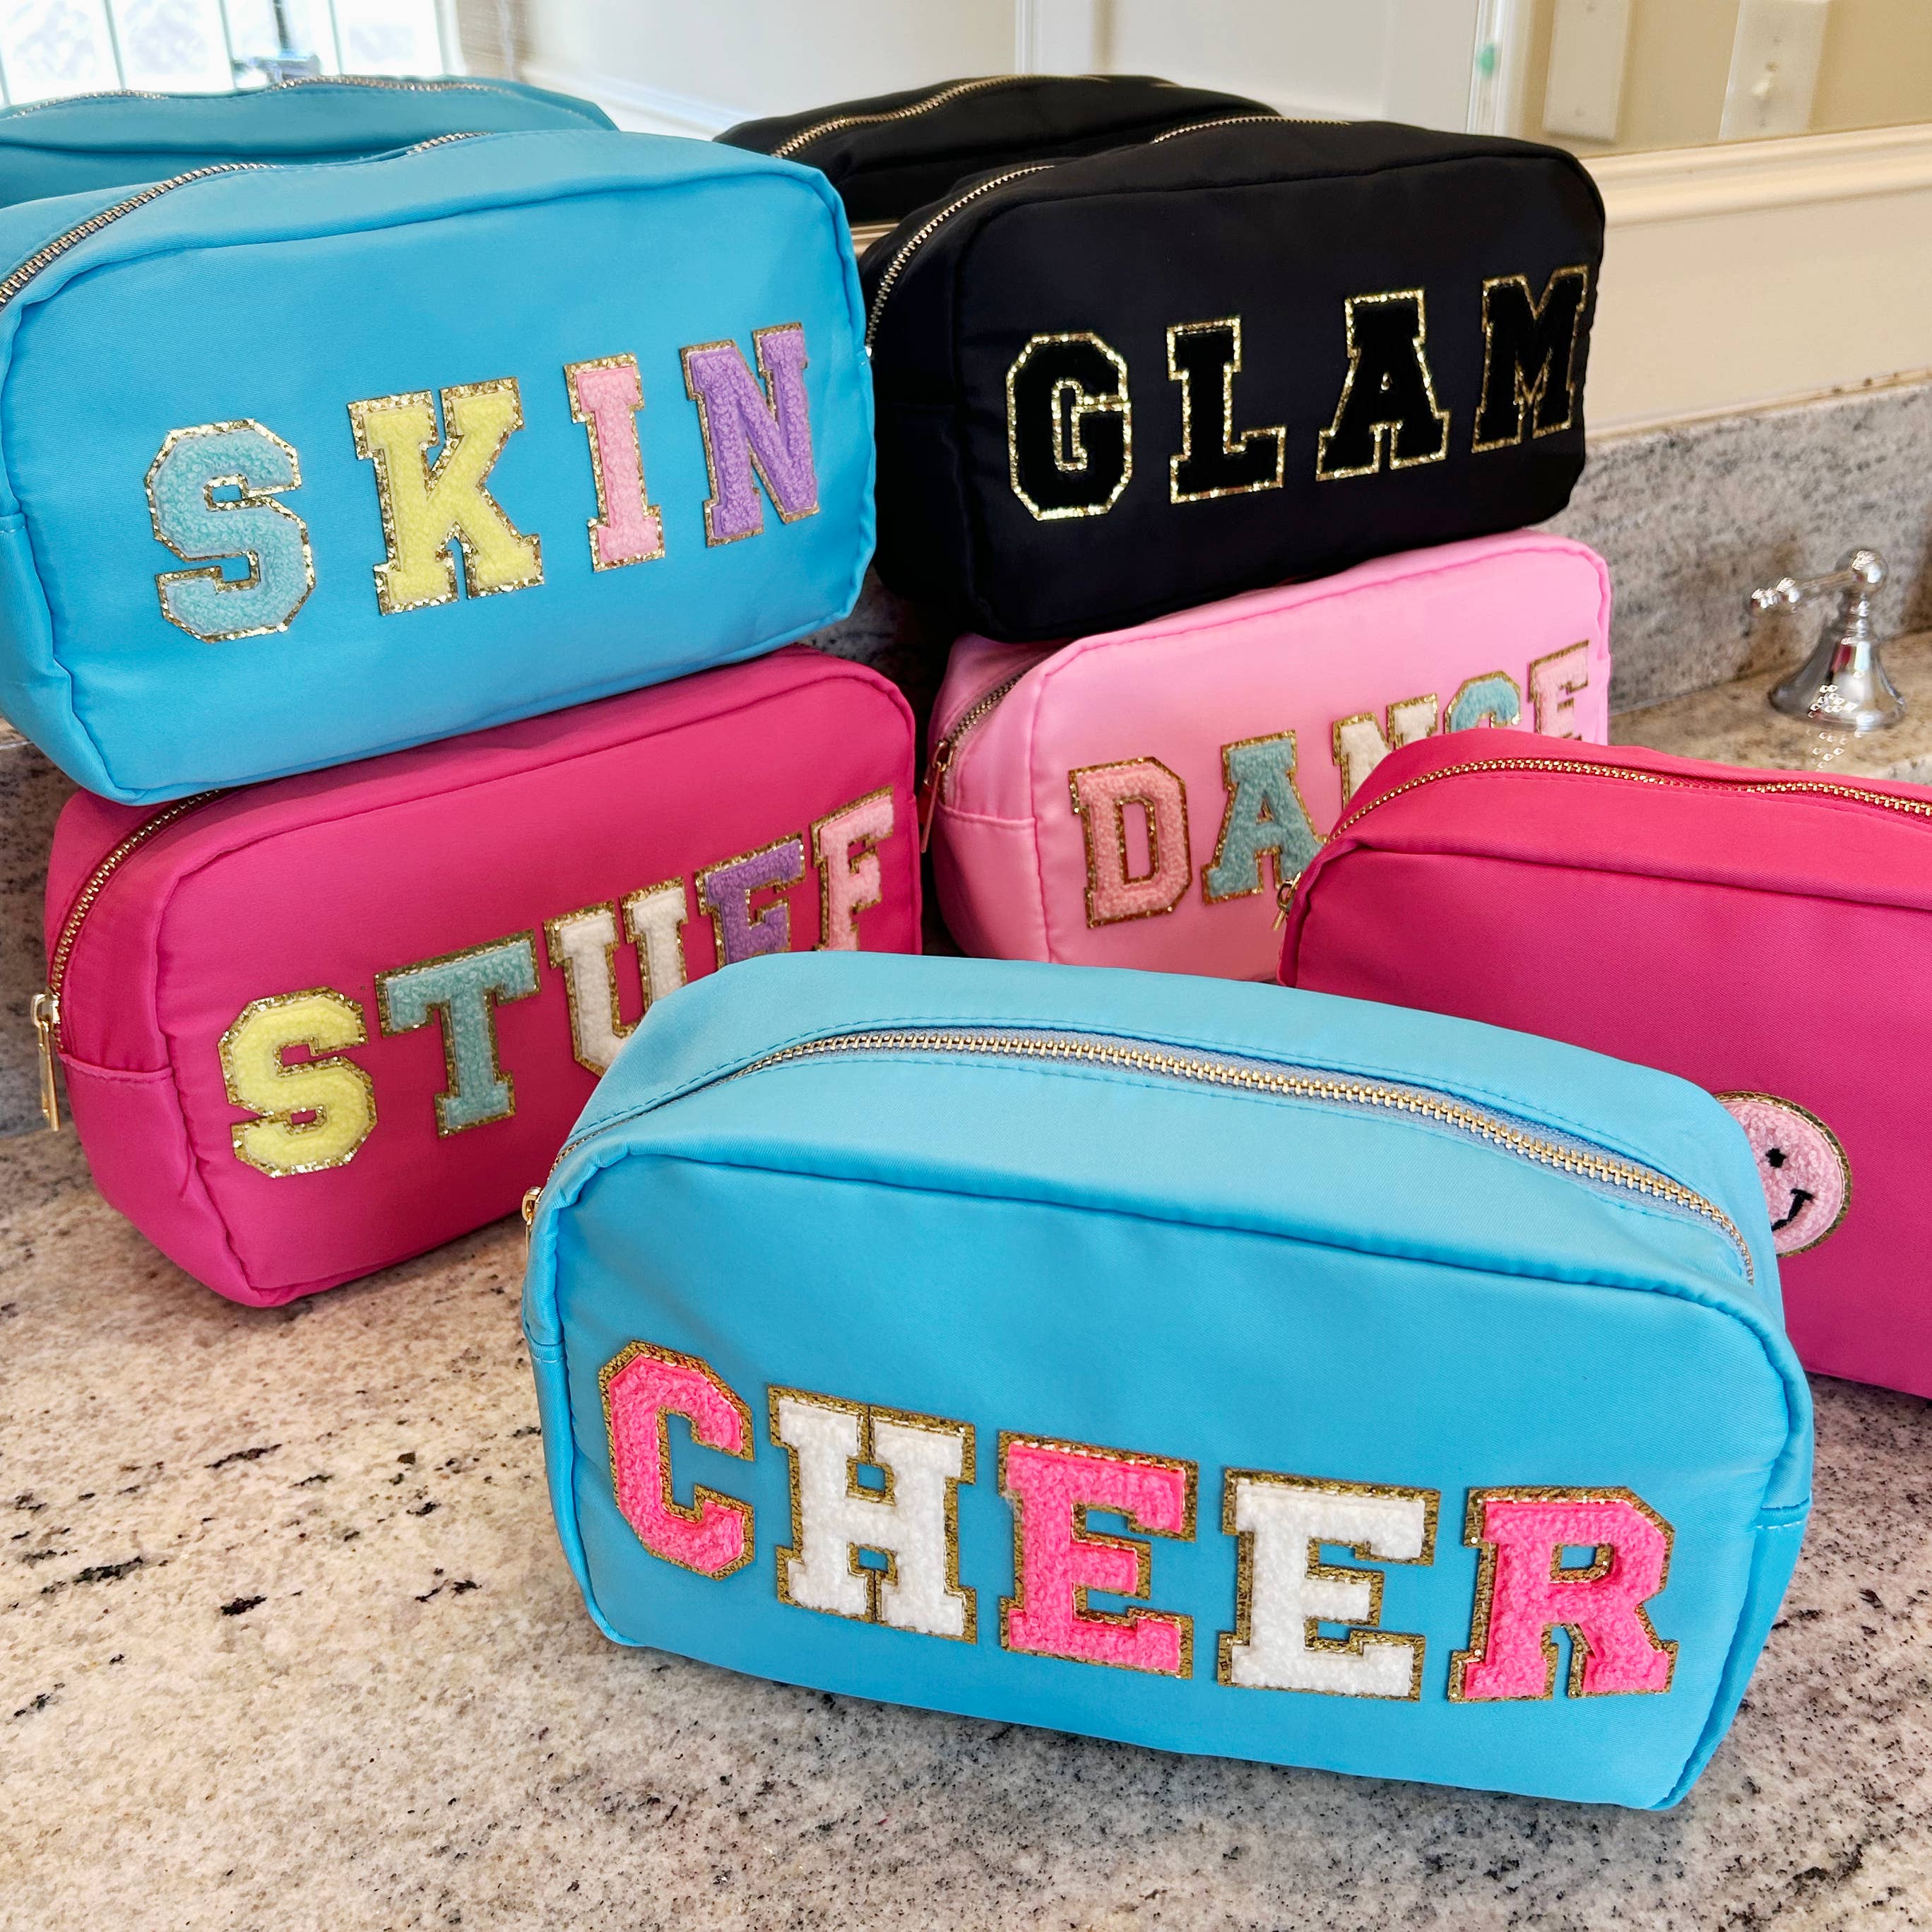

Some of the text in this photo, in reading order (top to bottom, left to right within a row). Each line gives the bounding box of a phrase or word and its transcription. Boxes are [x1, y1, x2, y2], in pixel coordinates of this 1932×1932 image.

[146, 323, 819, 643] SKIN
[1007, 264, 1589, 521] GLAM
[598, 1339, 1678, 1704] CHEER
